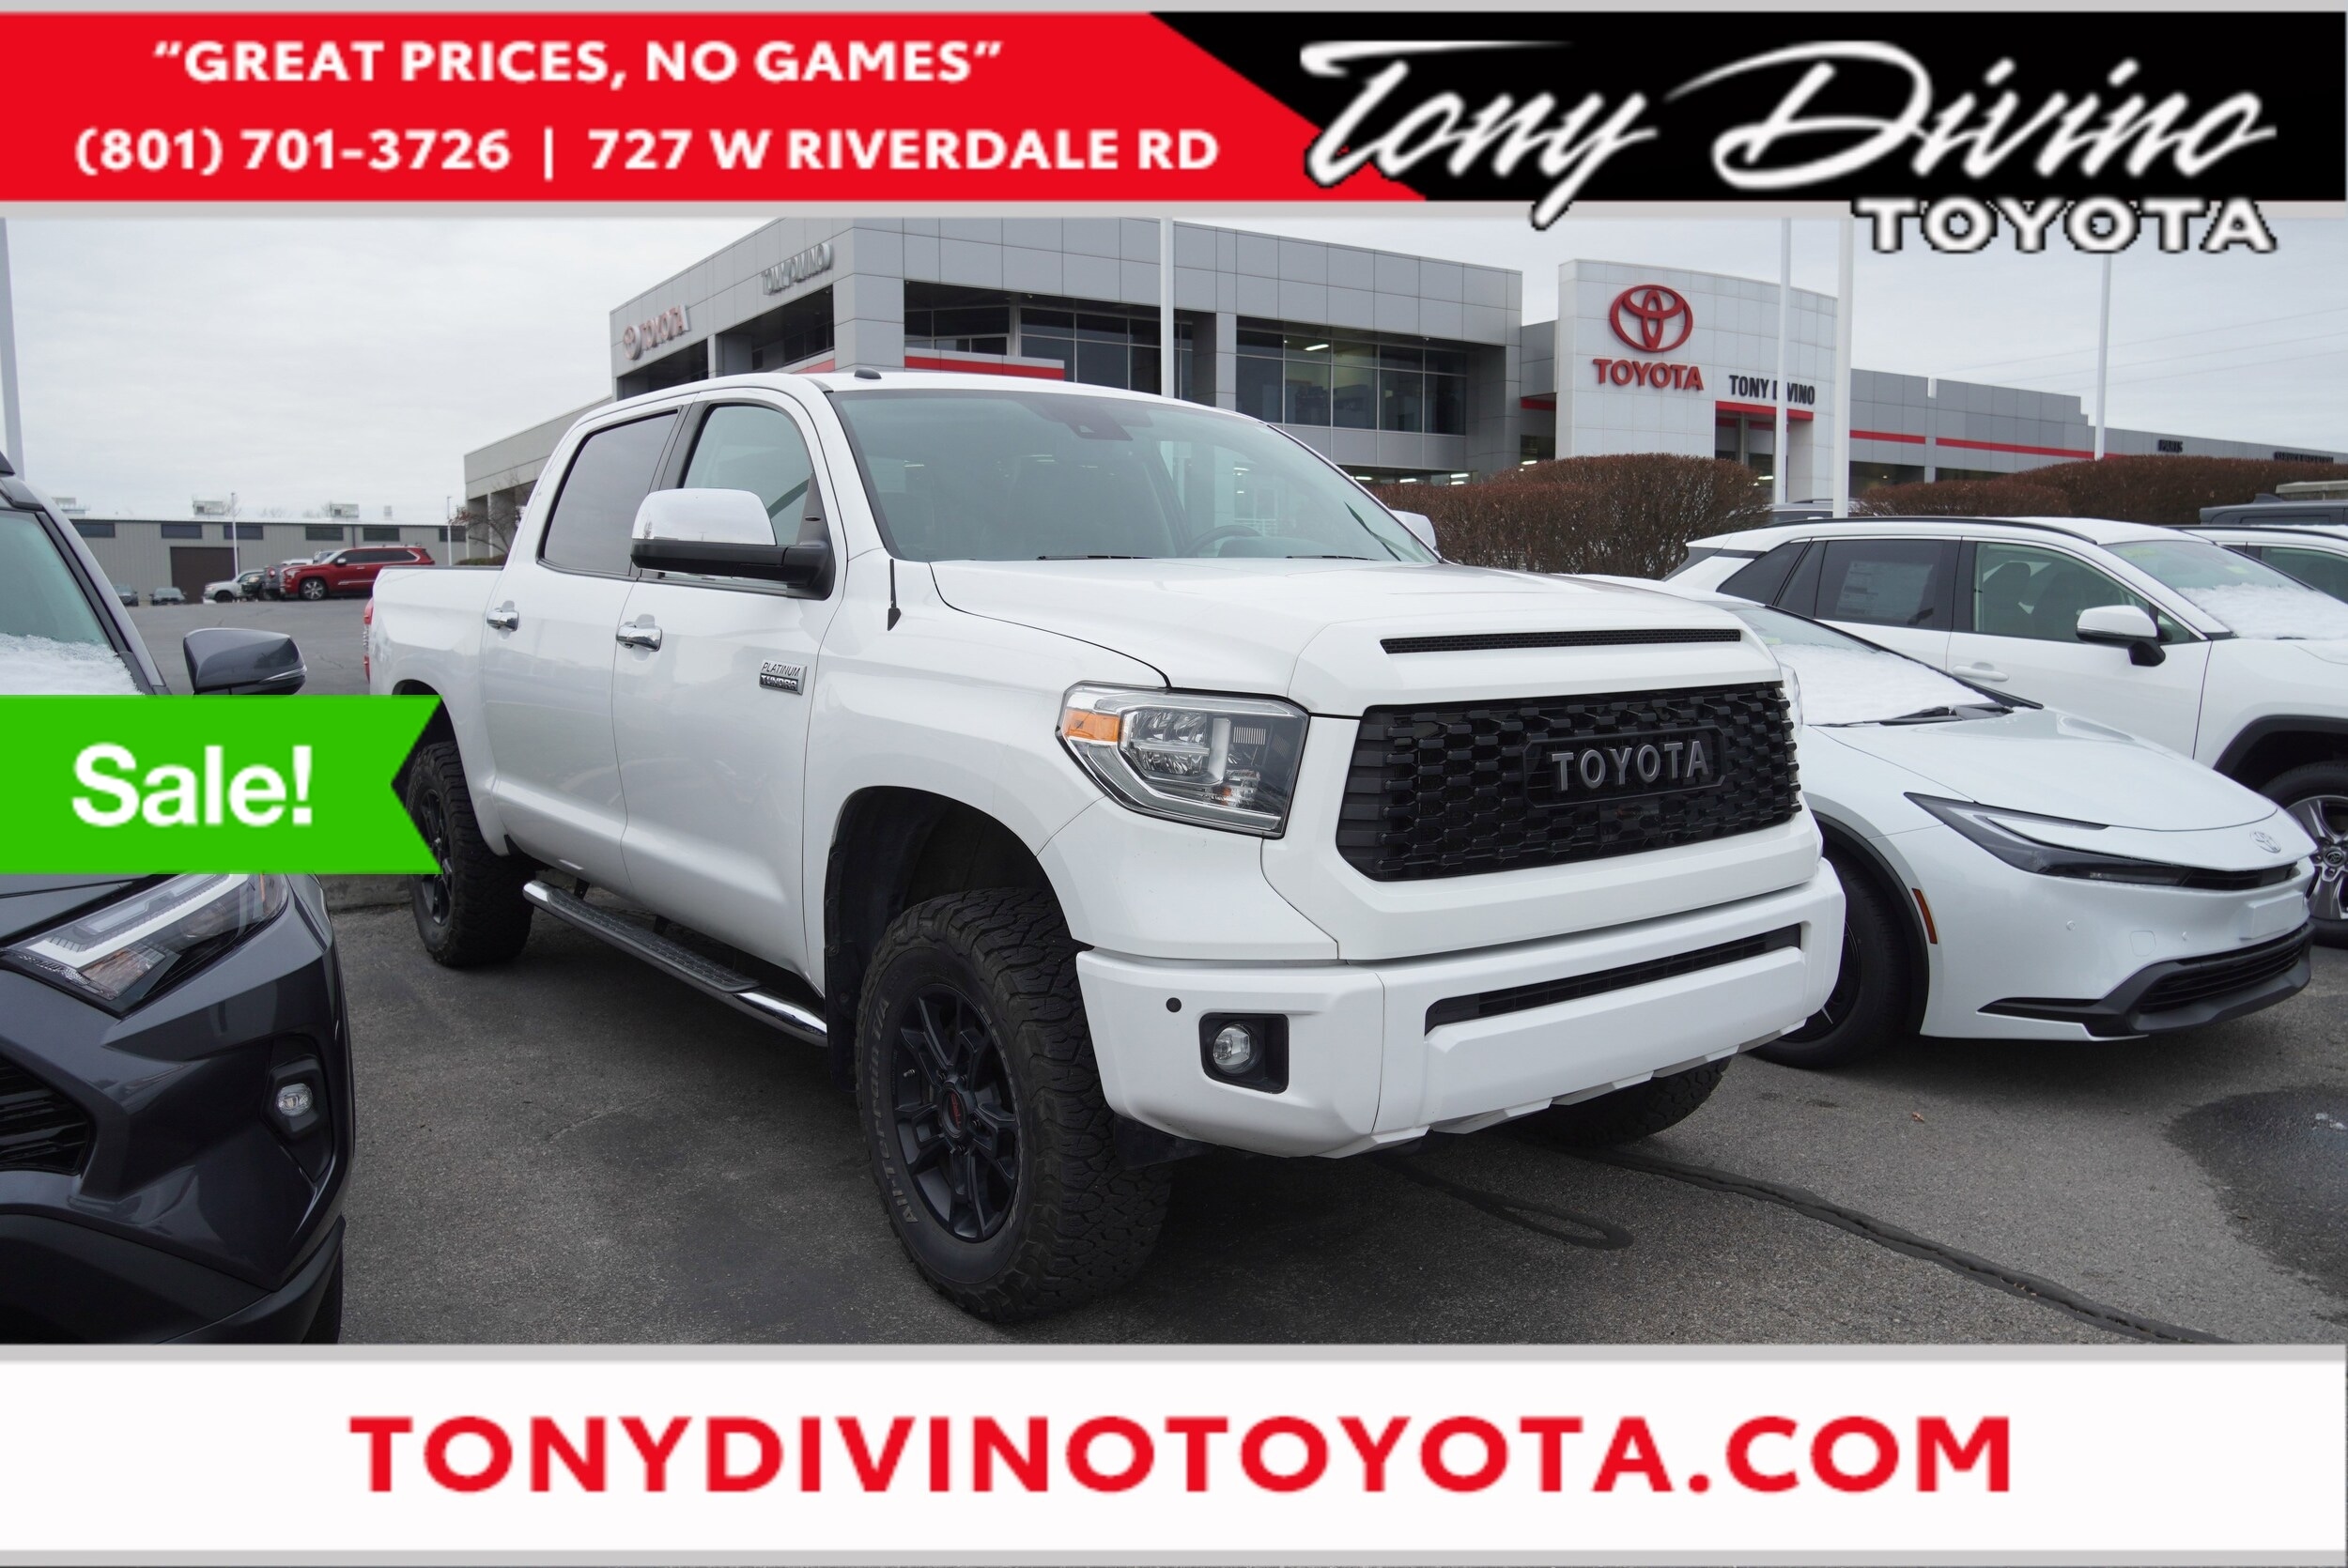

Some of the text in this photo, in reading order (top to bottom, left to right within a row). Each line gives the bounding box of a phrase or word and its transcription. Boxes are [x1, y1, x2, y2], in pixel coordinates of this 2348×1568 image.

[640, 304, 690, 350] TOYOTA
[1592, 358, 1705, 391] TOYOTA
[1729, 375, 1769, 398] TONY
[762, 662, 801, 677] PLATINUM
[1551, 739, 1709, 793] TOYOTA
